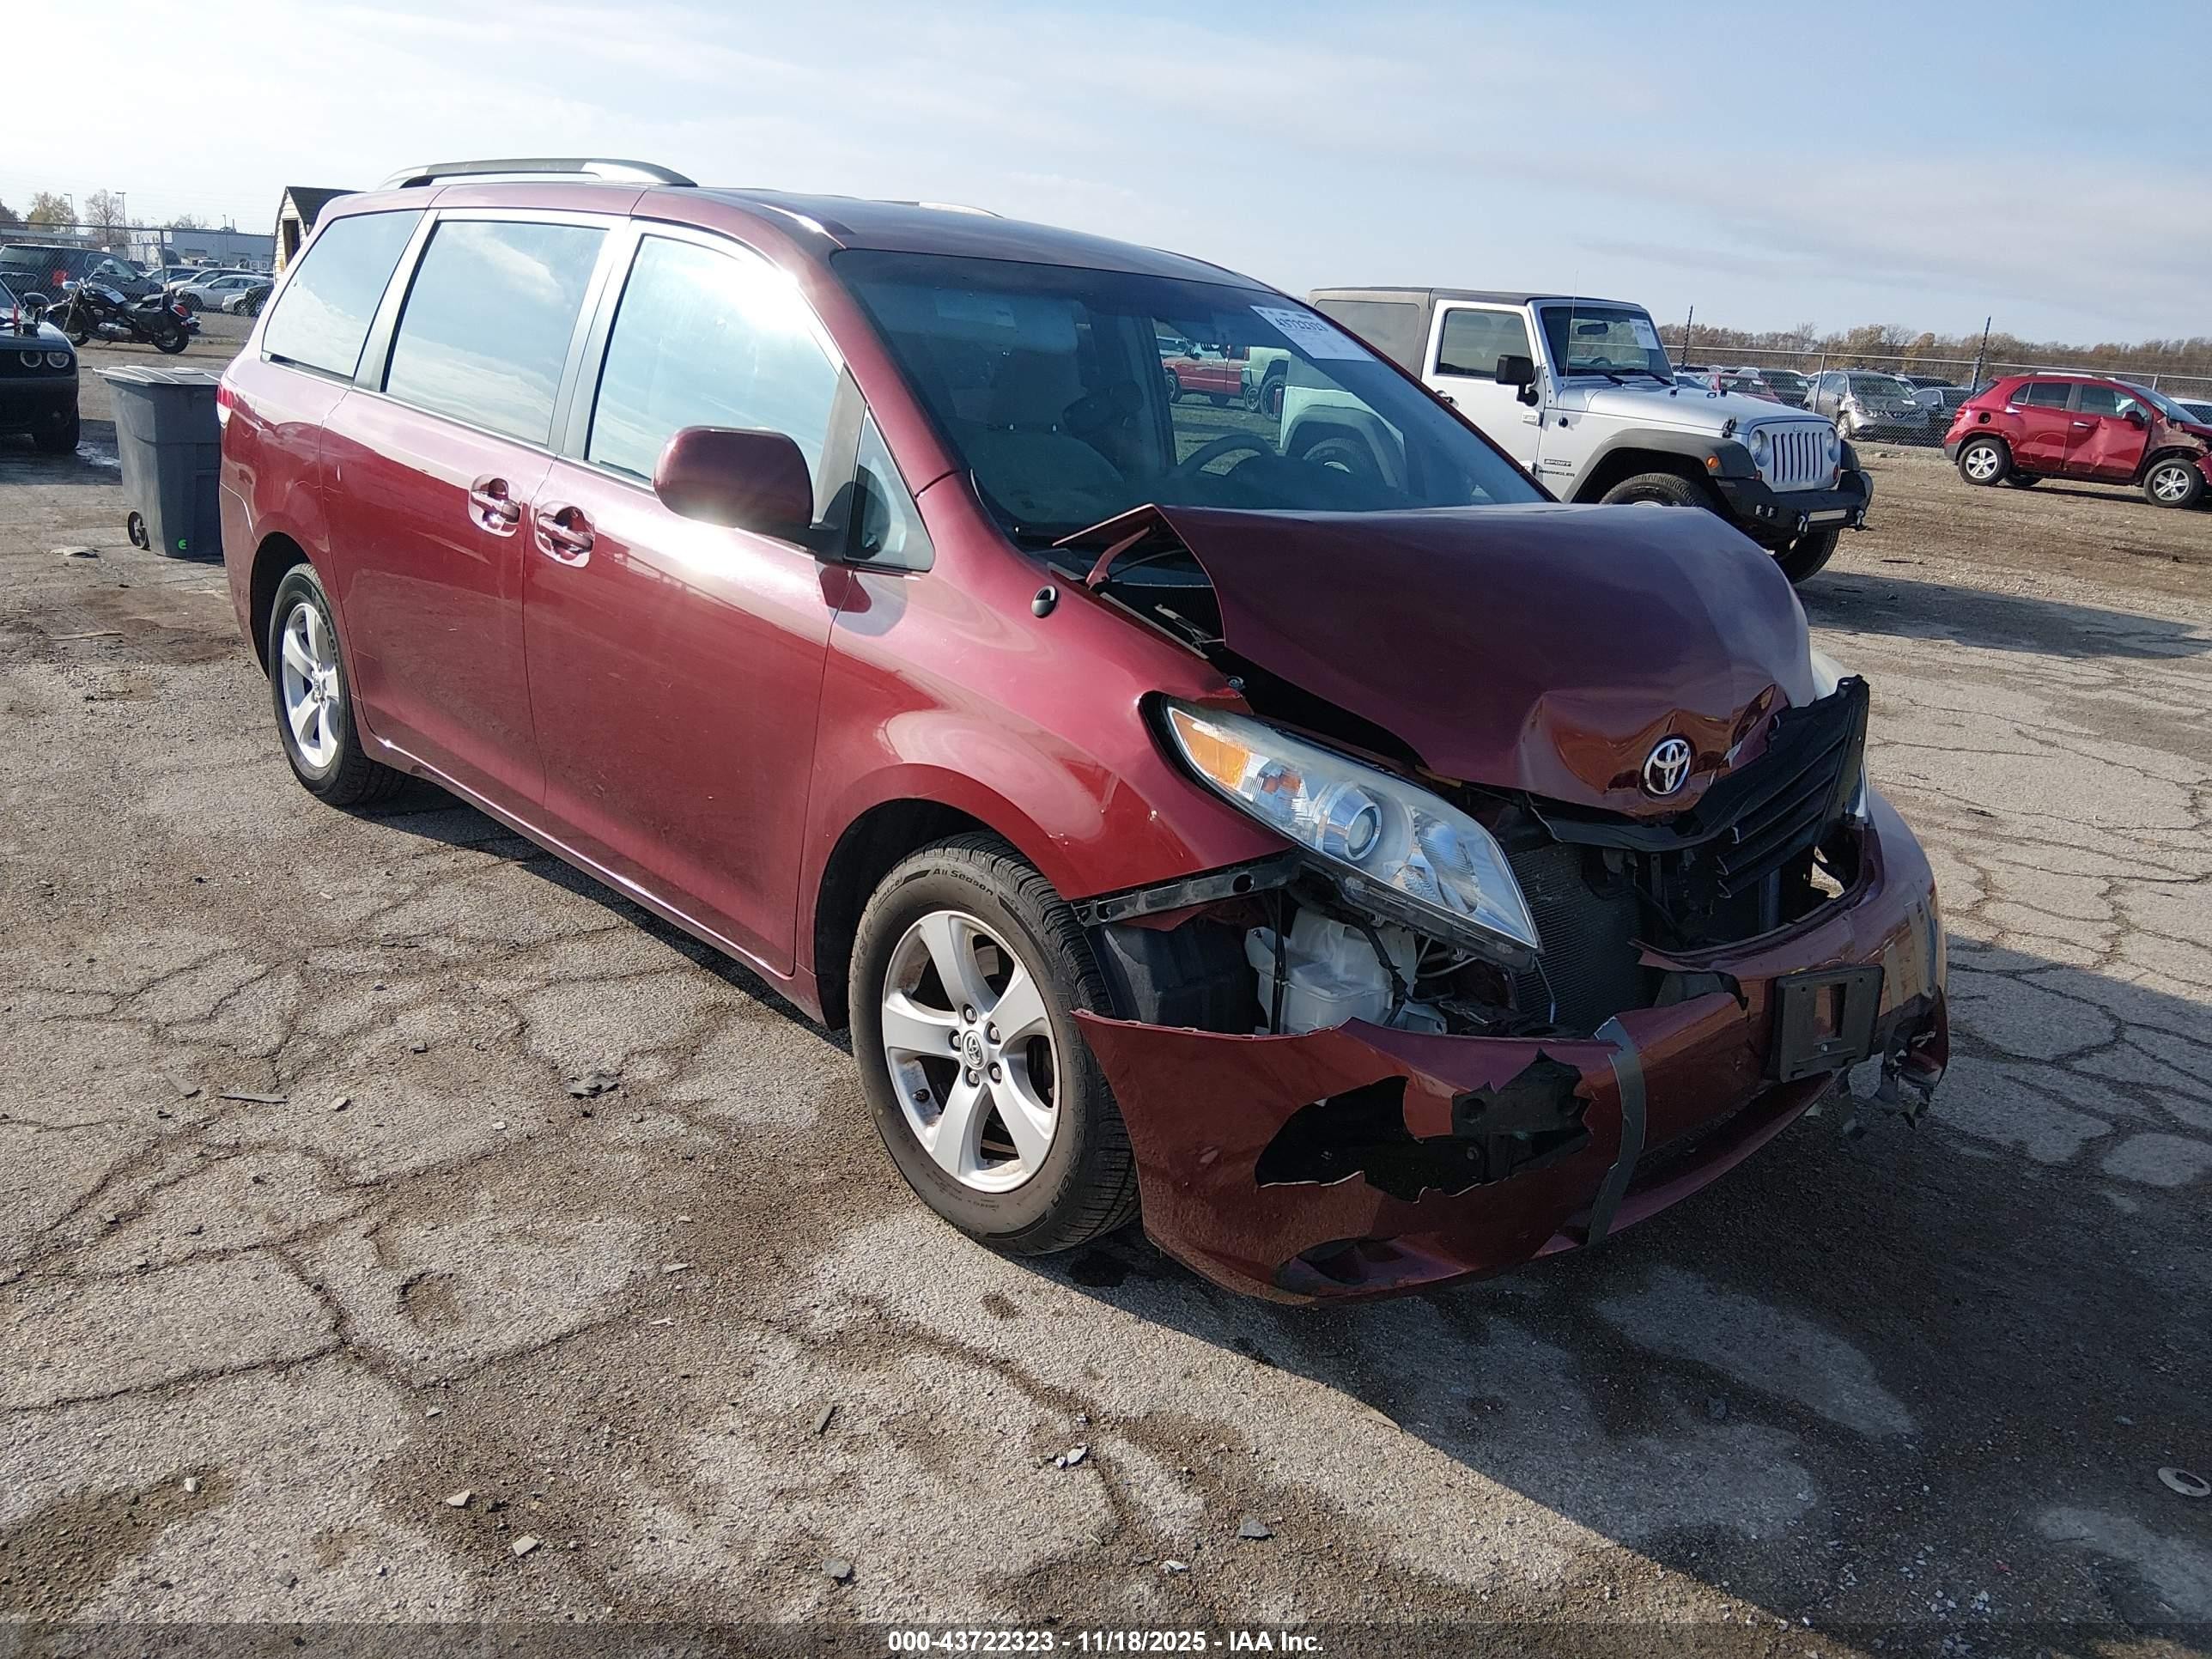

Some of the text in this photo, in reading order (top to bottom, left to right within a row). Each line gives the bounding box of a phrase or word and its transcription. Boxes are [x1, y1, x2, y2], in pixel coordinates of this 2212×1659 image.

[872, 868, 994, 912] Control All Season
